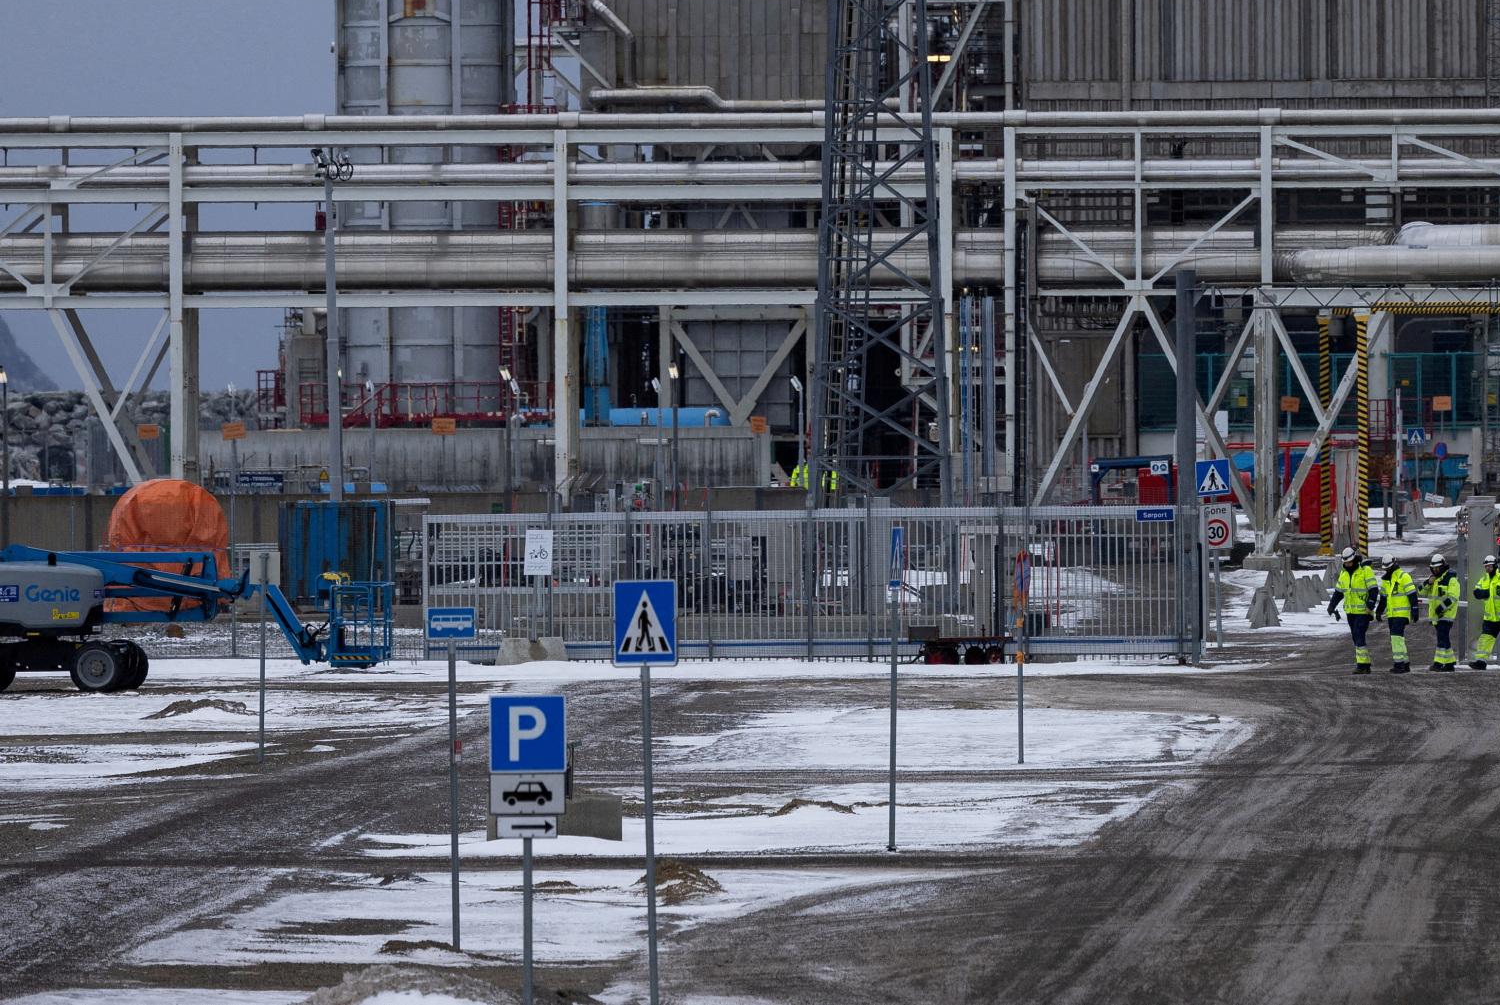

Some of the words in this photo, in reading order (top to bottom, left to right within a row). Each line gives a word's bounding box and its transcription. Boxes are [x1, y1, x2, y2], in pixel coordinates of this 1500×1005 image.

[1208, 526, 1224, 539] 30
[25, 583, 81, 602] Genie
[508, 705, 547, 762] P
